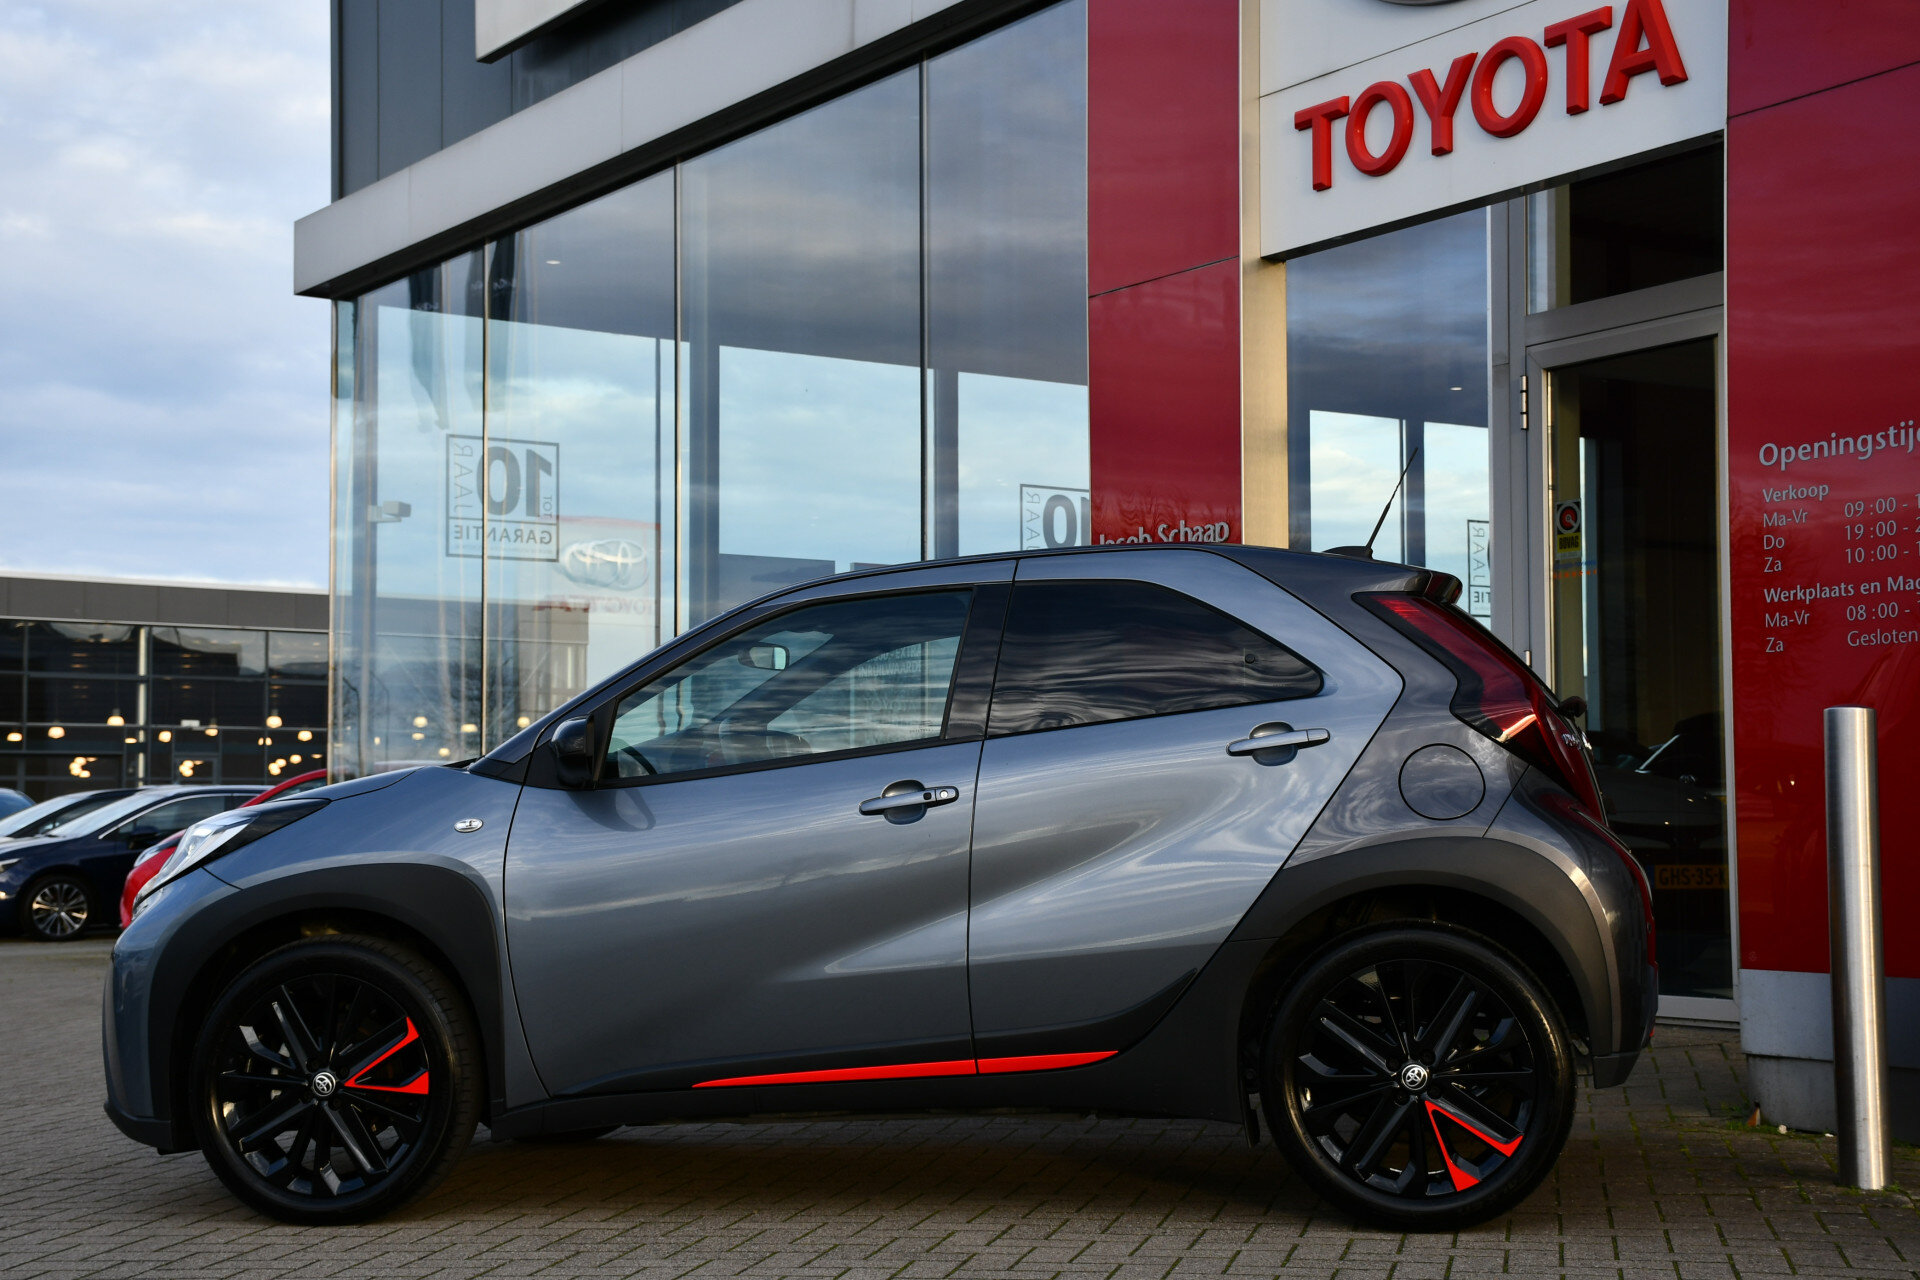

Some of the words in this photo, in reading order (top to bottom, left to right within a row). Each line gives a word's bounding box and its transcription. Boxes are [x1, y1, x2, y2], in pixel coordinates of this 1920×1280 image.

[1294, 0, 1688, 192] TOYOTA
[1758, 420, 1920, 471] Openingstij
[1763, 483, 1829, 503] Verkoop
[1763, 508, 1808, 528] Ma-Vr
[1558, 535, 1579, 550] BOVAG
[1763, 534, 1785, 550] Do
[1763, 557, 1782, 573] Za
[1764, 582, 1854, 605] Werkplaats
[1860, 581, 1881, 595] en
[1765, 609, 1810, 628] Ma-Vr
[1766, 637, 1784, 652] Za
[1847, 628, 1919, 647] Gesloten
